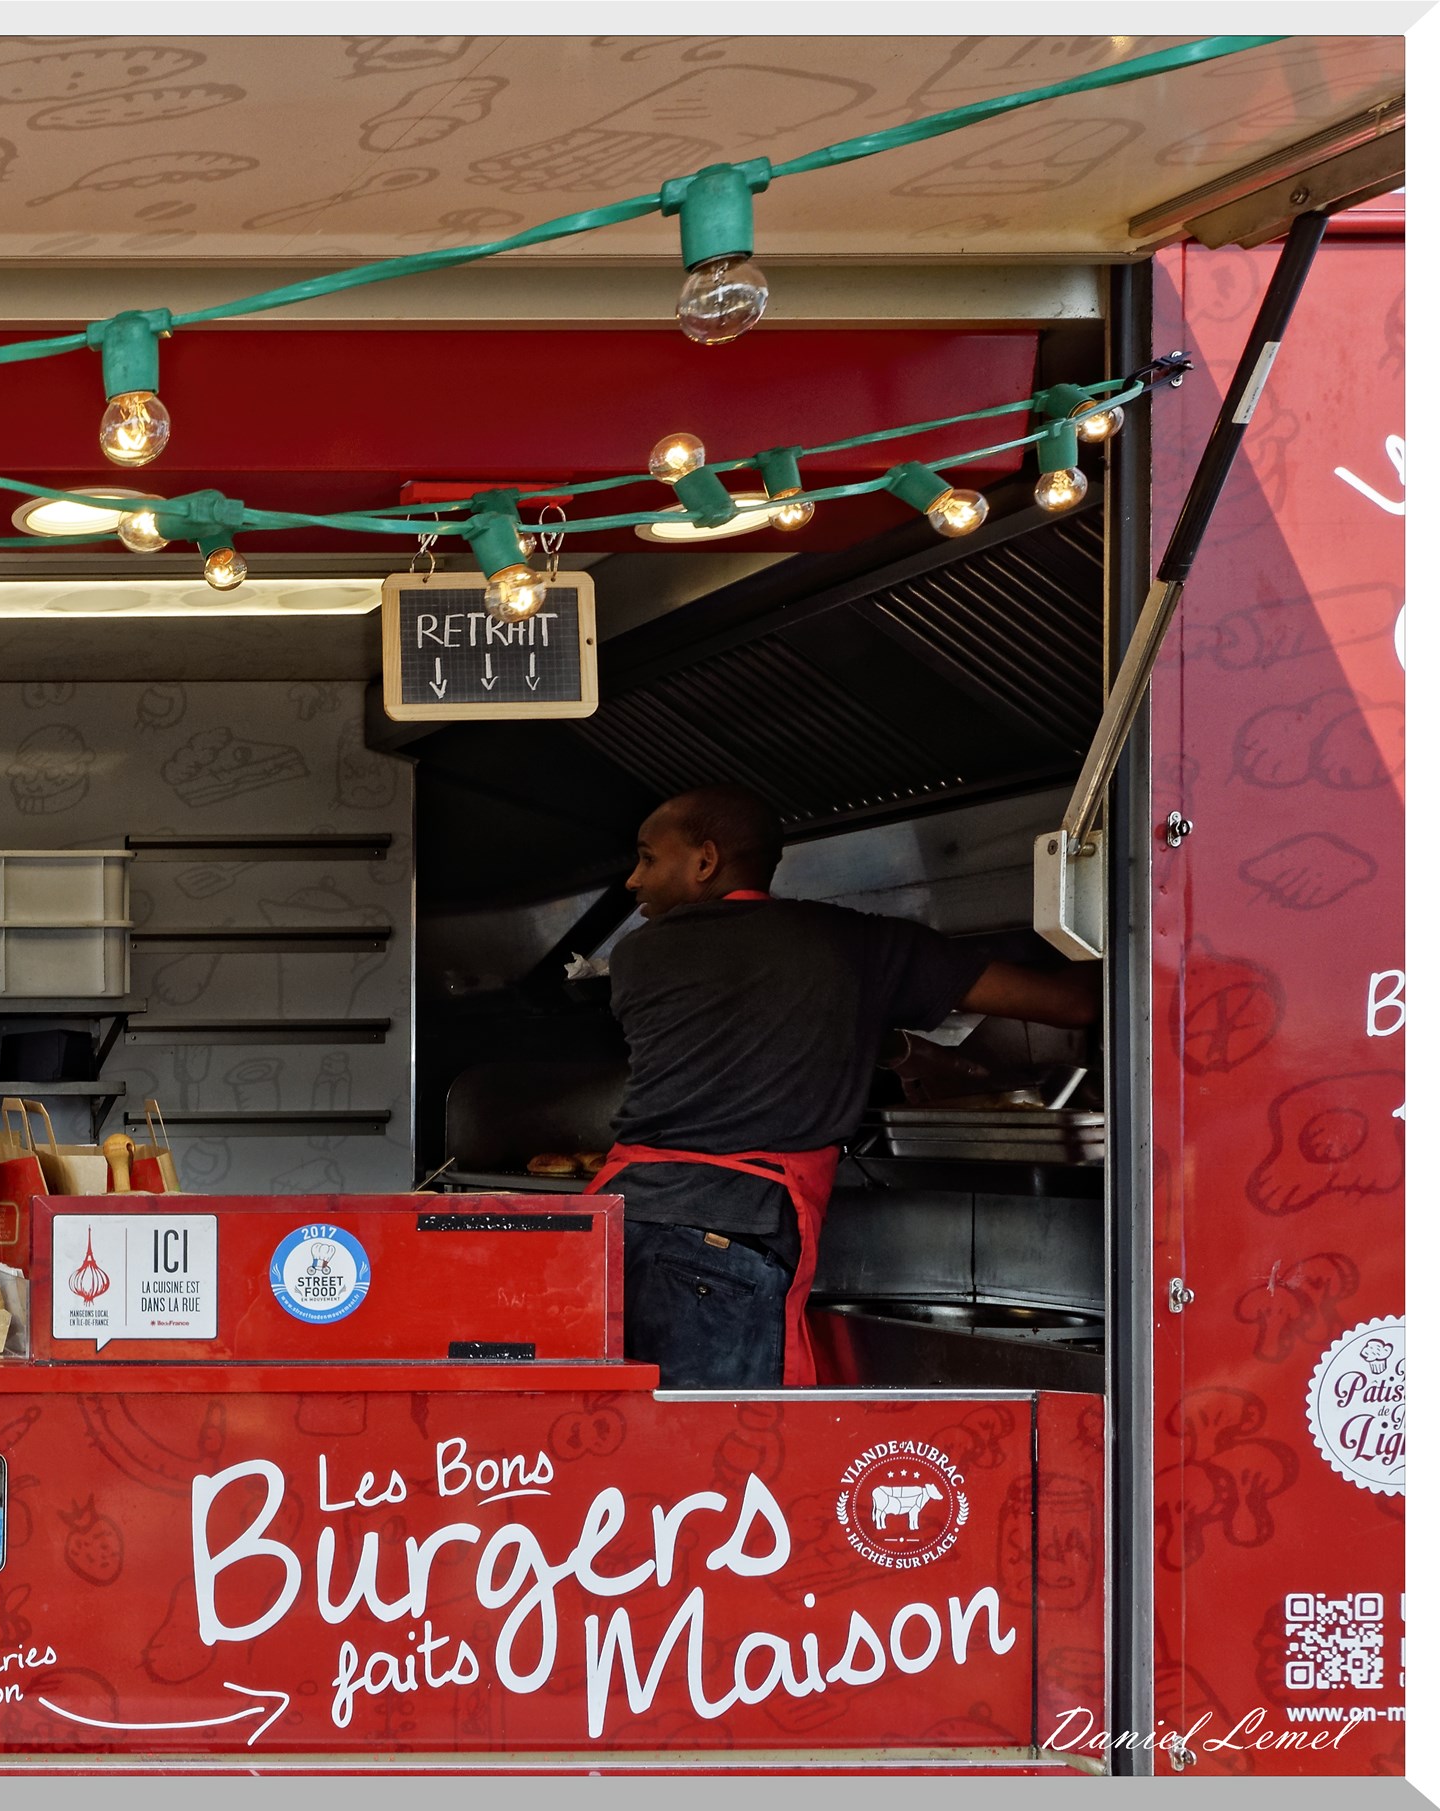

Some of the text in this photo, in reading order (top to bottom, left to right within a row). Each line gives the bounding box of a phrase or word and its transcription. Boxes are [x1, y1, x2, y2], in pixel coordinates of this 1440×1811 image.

[417, 612, 558, 649] RETRAIT
[301, 1225, 337, 1240] 2017
[153, 1229, 188, 1274] ICI
[141, 1281, 200, 1294] LA CUISINE EST
[297, 1275, 344, 1287] STREET
[304, 1286, 337, 1297] FOOD
[69, 1310, 109, 1318] MANGEONS LOCAL
[141, 1297, 200, 1313] DANS LA RUE
[69, 1317, 109, 1326] EN ÎLE-DE-FRANCE
[1334, 1370, 1405, 1408] Pâtis
[1377, 1405, 1390, 1417] de
[318, 1437, 555, 1512] Les Bons
[840, 1440, 965, 1487] VIANDE d'AUBRAC
[847, 1532, 958, 1569] HACHÉE SUR PLACE
[191, 1458, 792, 1696] Burgers
[332, 1584, 1017, 1740] faits Maison
